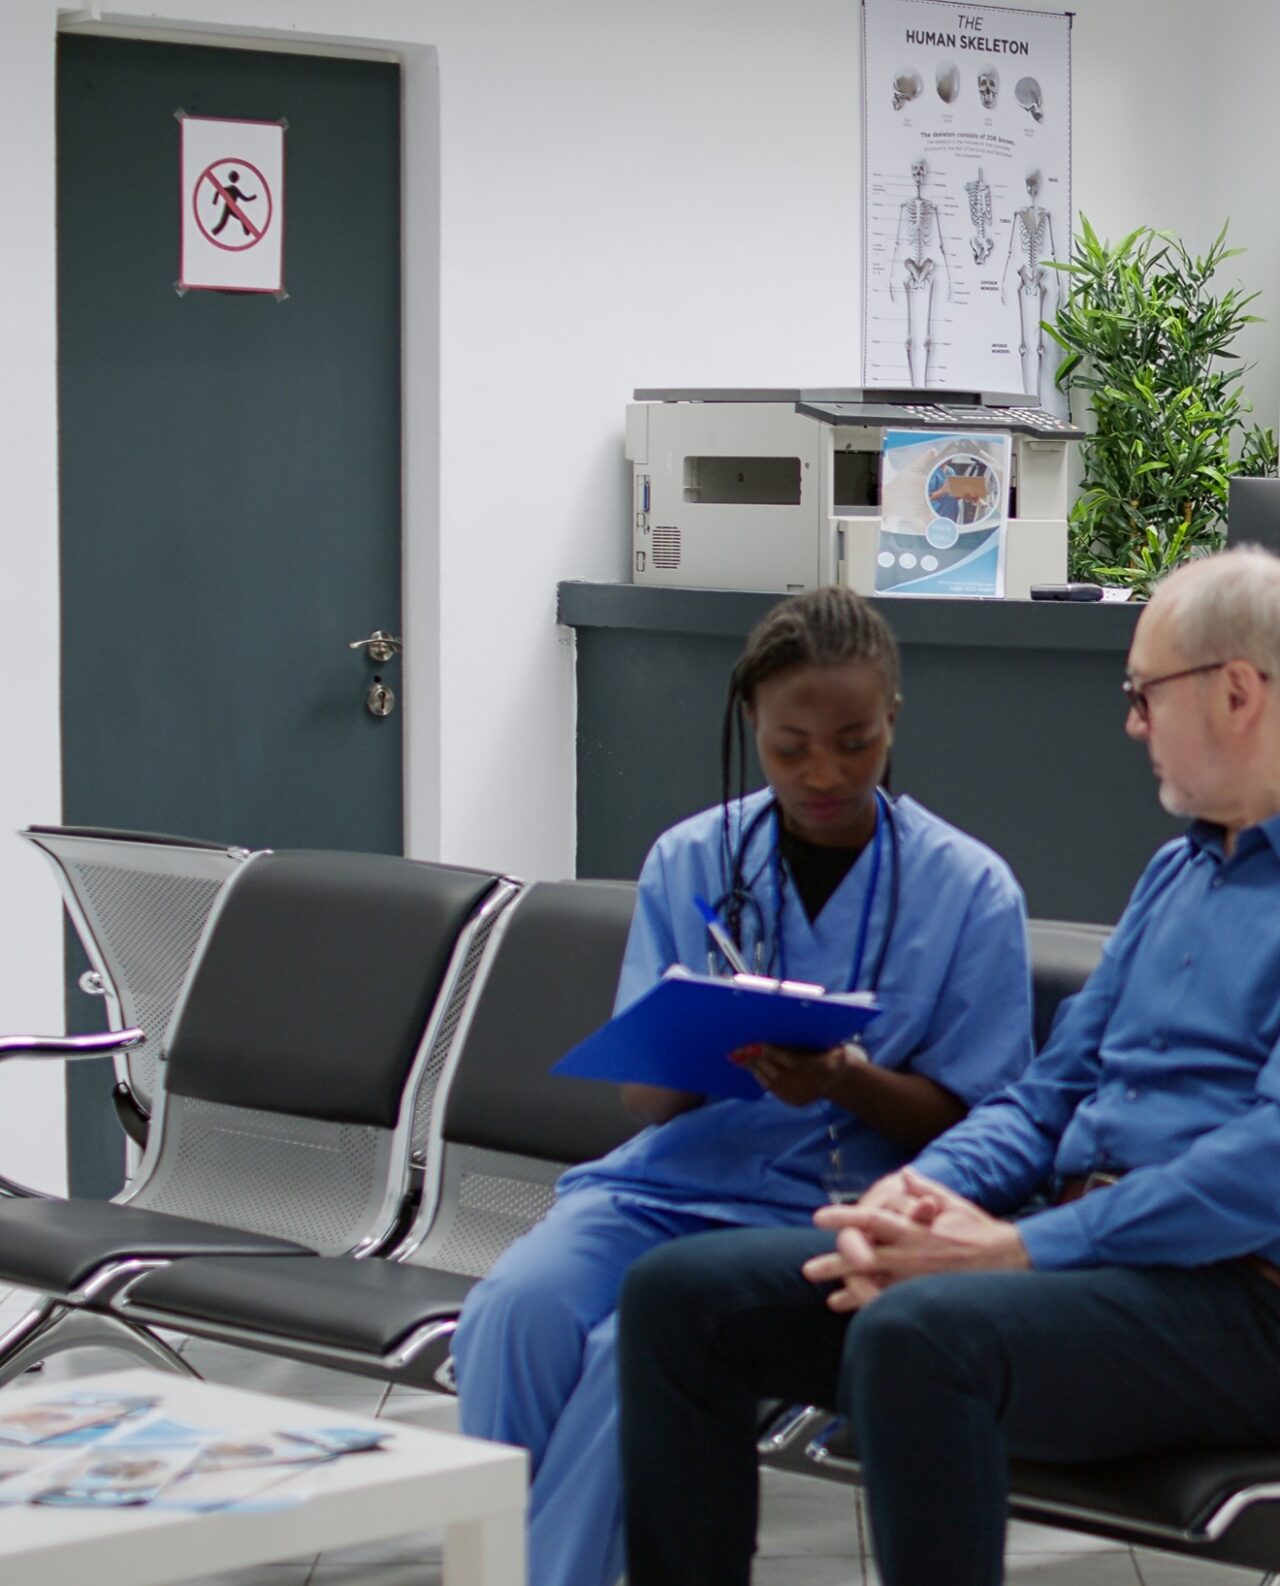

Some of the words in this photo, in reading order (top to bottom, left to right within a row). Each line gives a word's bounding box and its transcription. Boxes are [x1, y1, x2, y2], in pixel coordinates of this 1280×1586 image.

[957, 14, 984, 31] THE
[906, 29, 956, 48] HUMAN
[960, 35, 1029, 56] SKELETON
